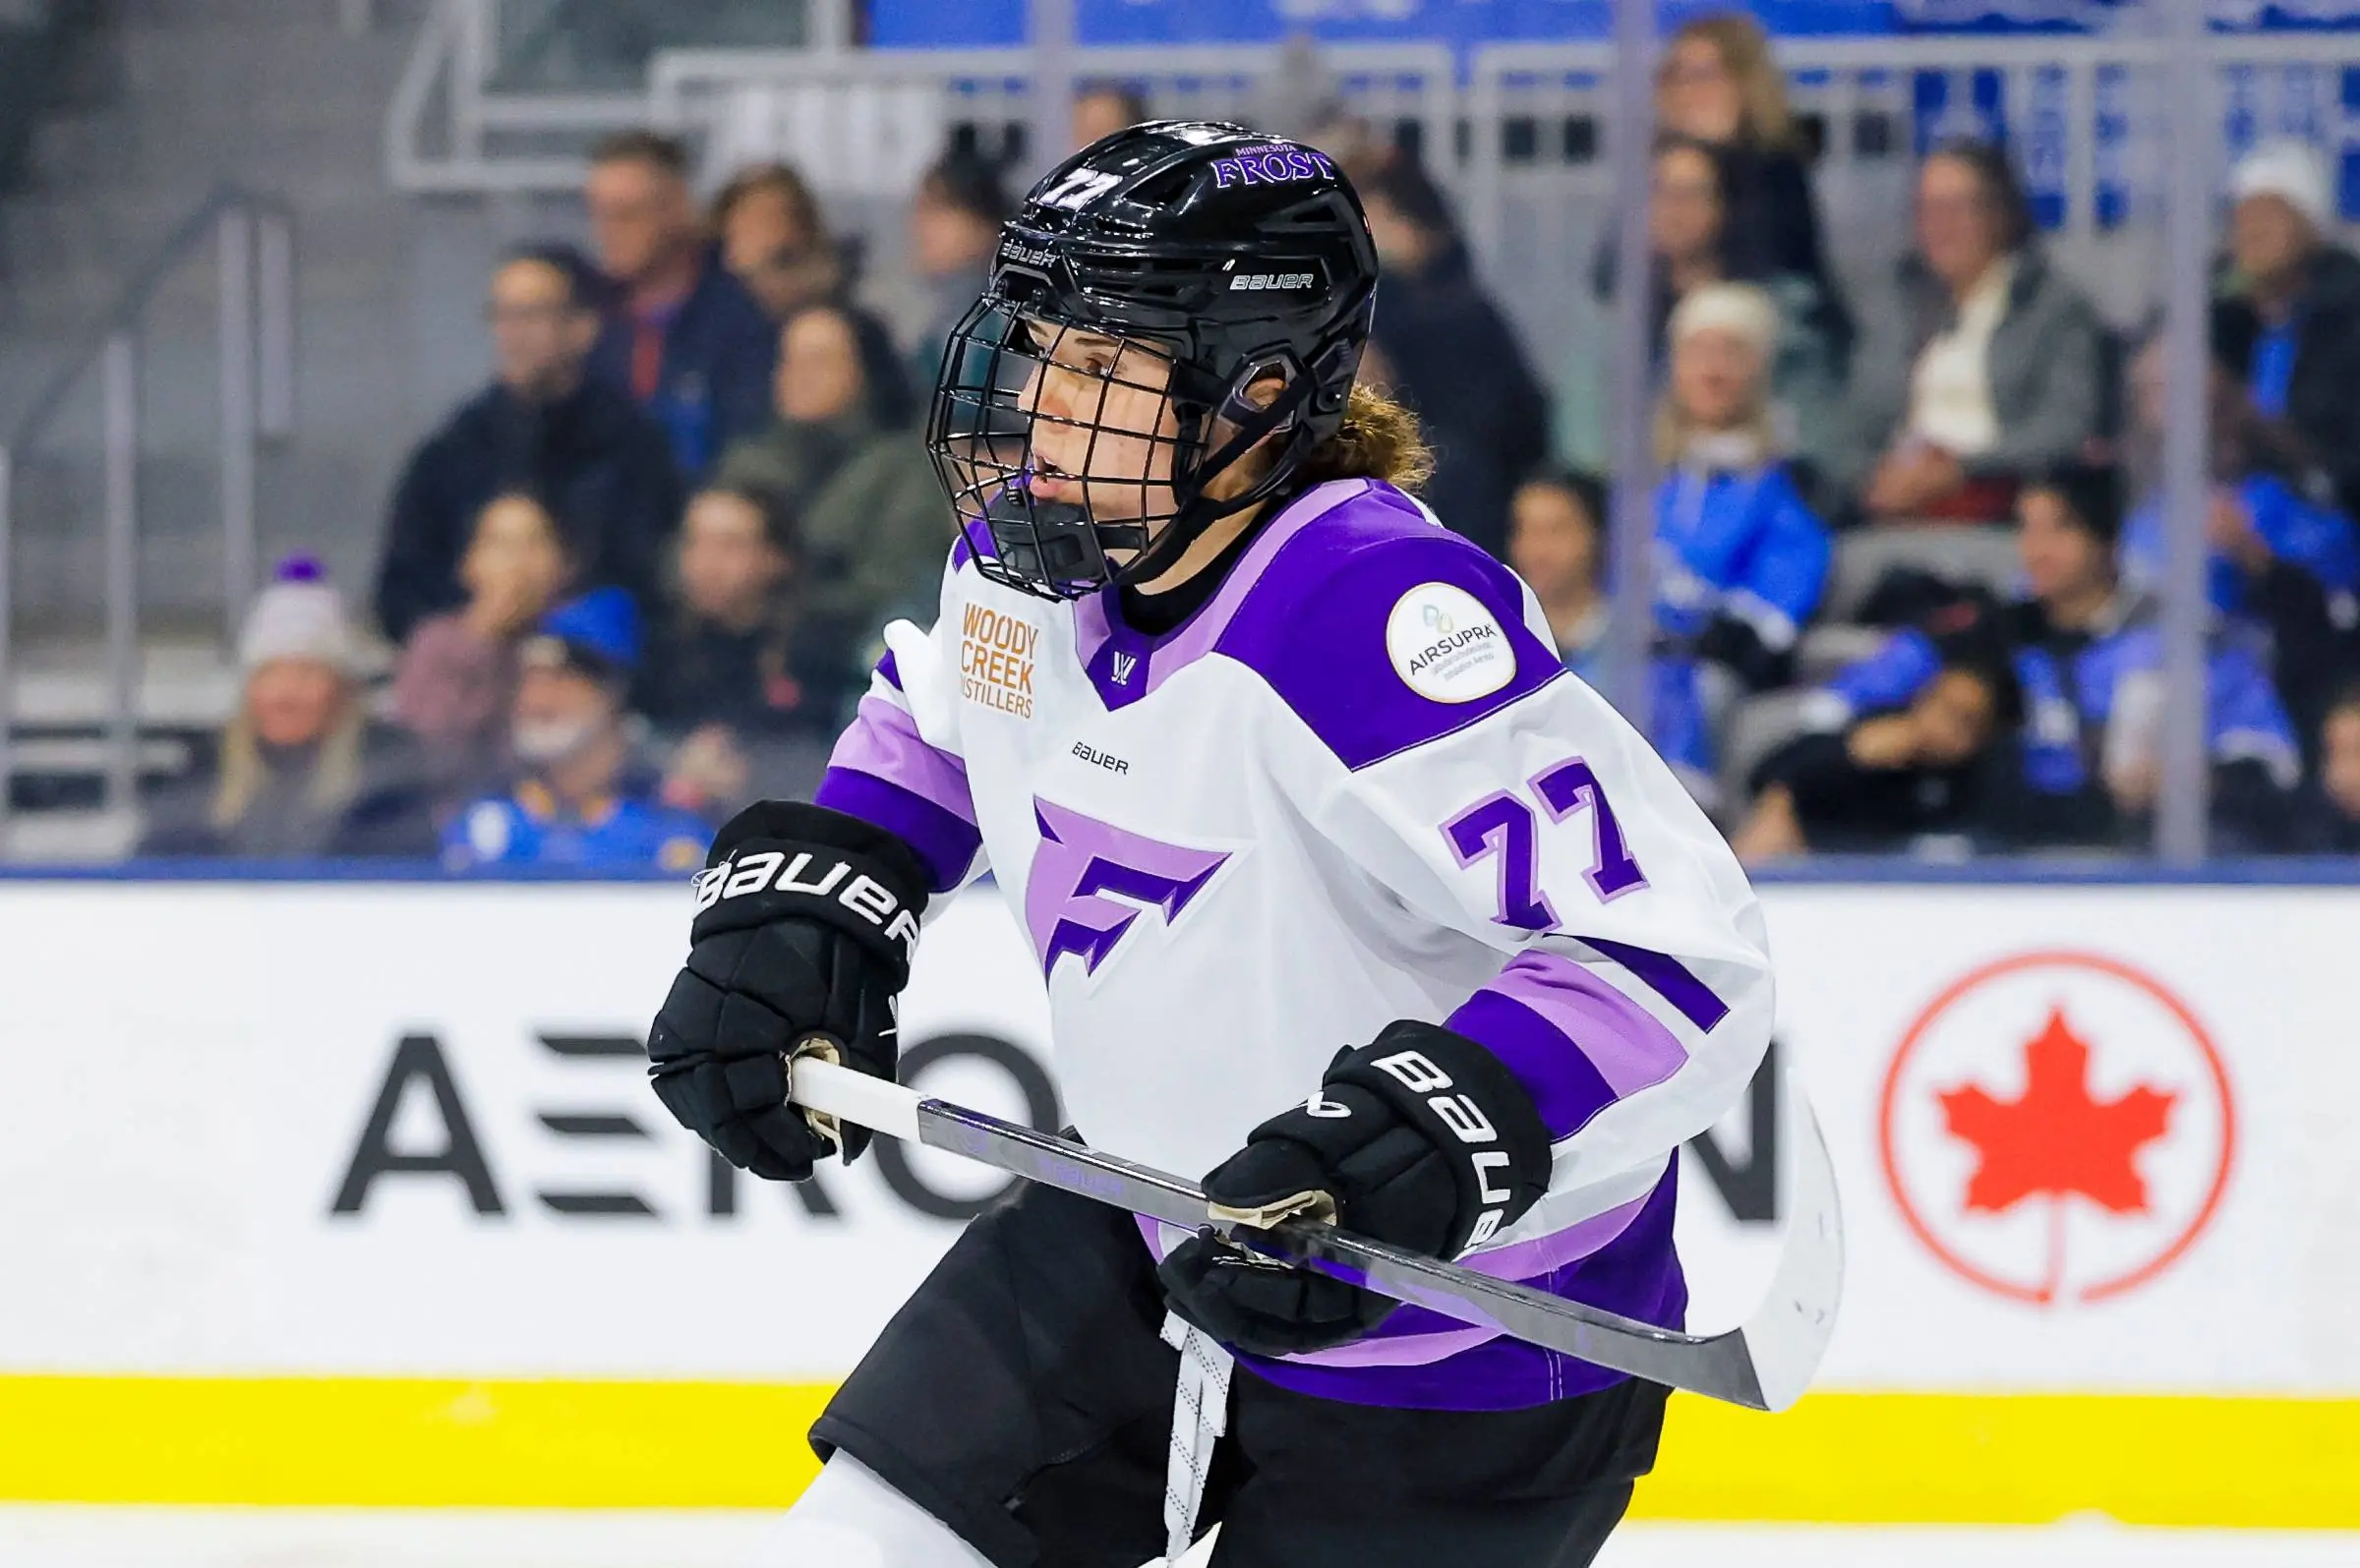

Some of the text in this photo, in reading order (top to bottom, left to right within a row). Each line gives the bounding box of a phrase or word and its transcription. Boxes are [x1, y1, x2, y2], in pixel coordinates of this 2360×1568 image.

[1210, 152, 1336, 189] FROST
[1235, 144, 1298, 157] MINNESOTA
[963, 602, 1039, 660] WOODY
[961, 640, 1034, 694] CREEK
[1438, 755, 1651, 932] 77
